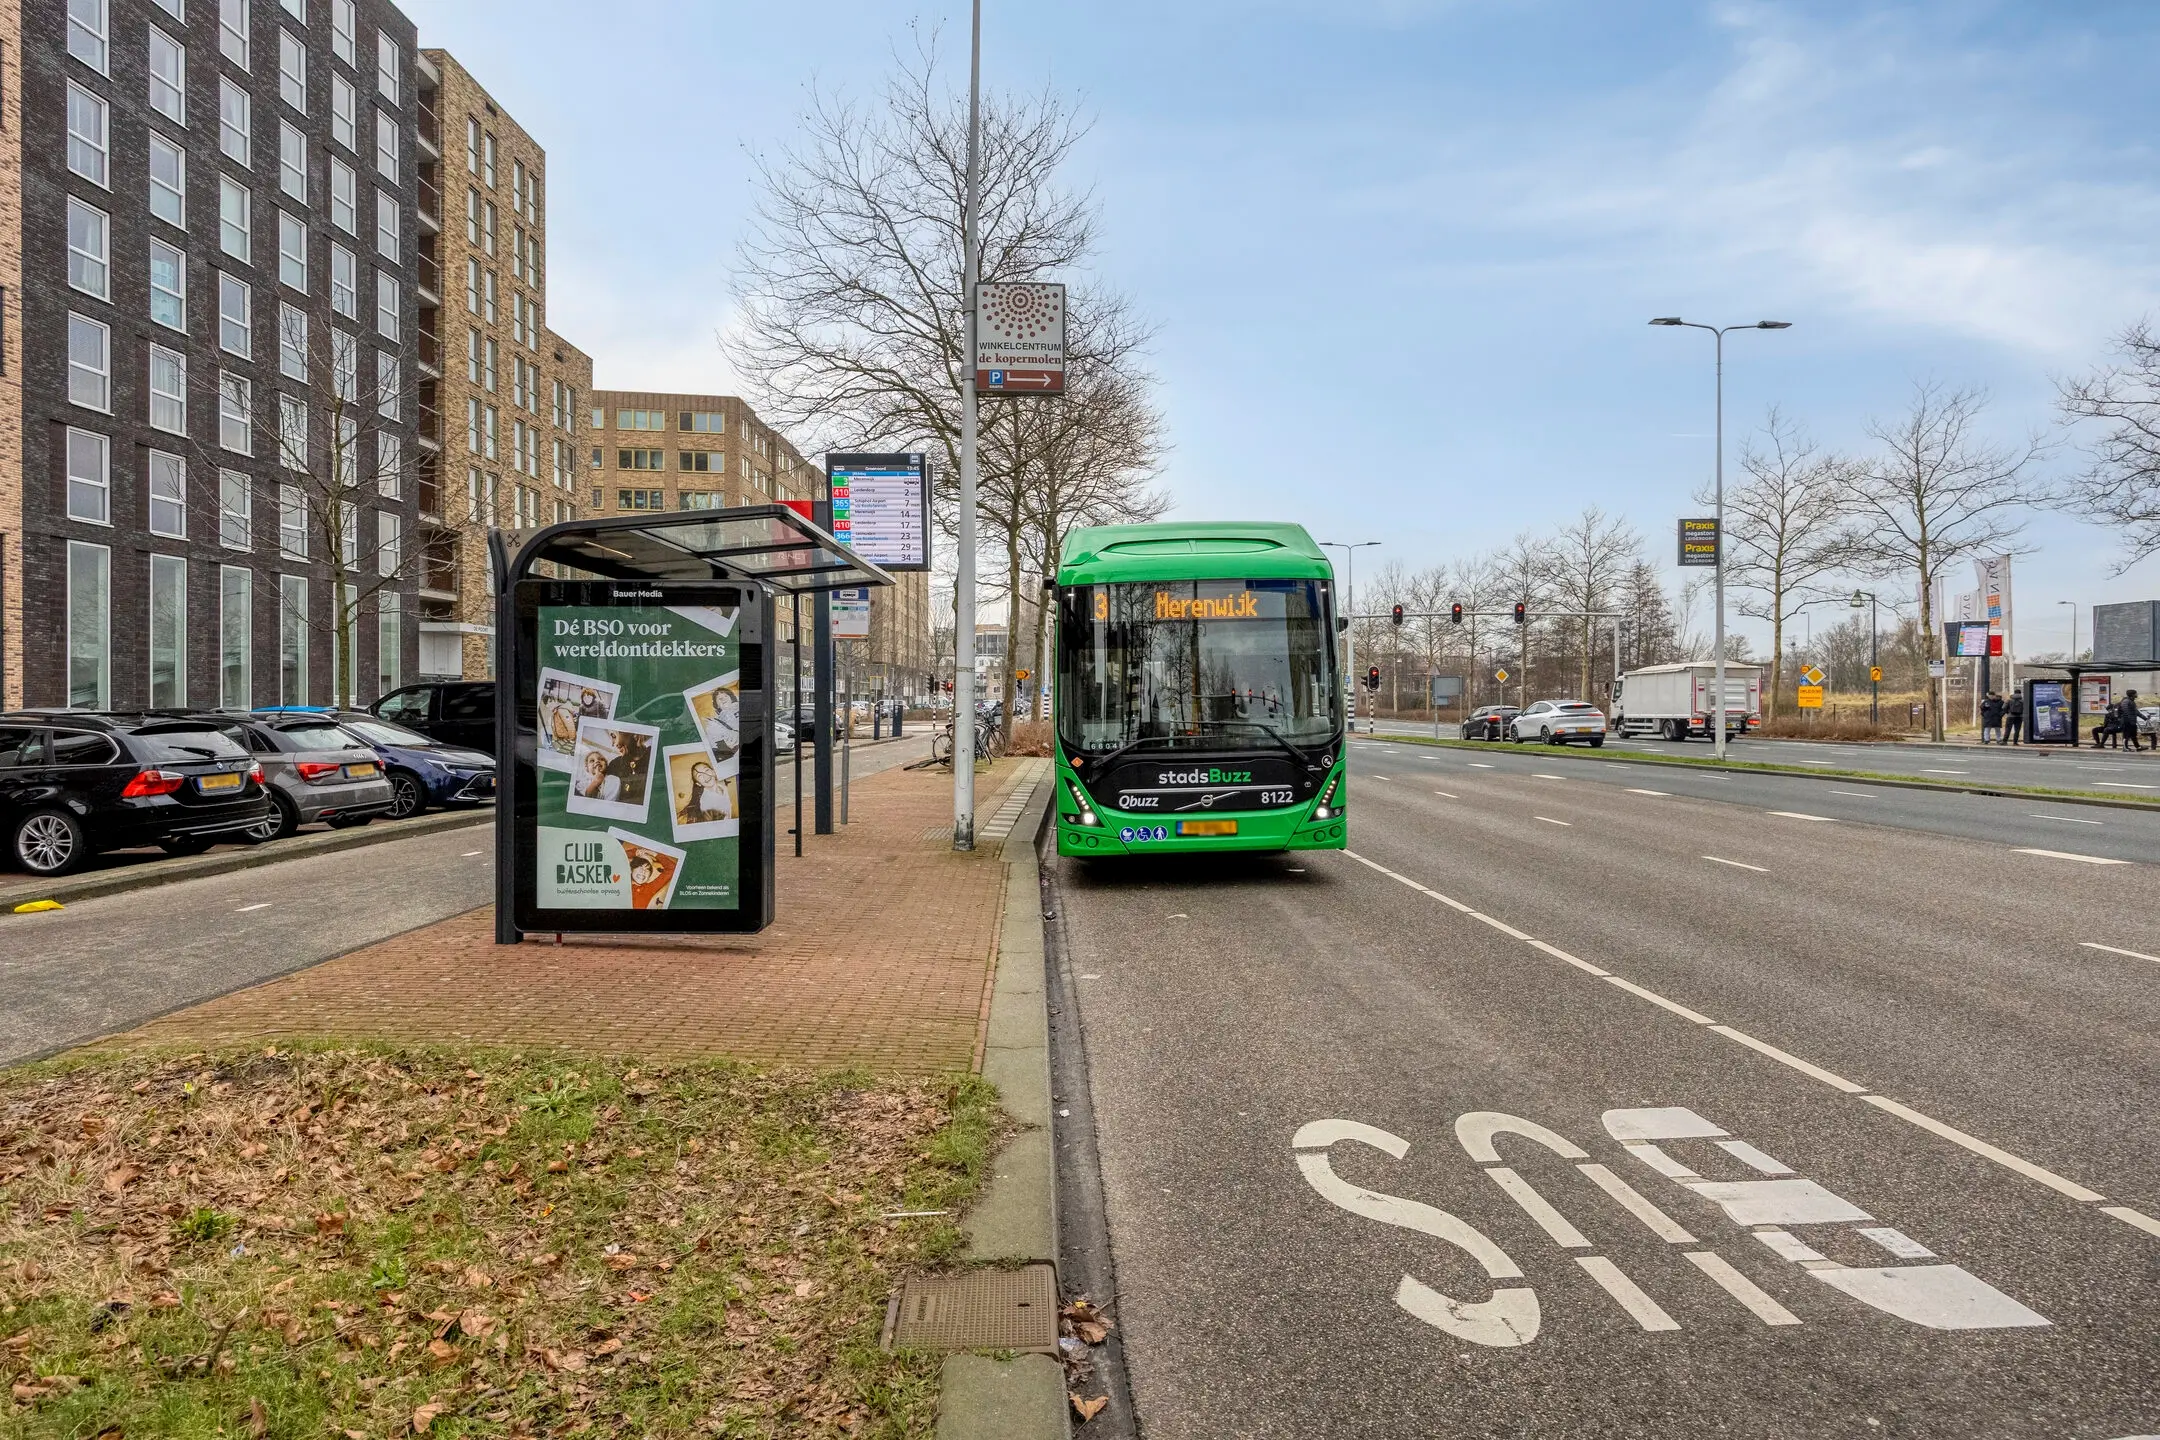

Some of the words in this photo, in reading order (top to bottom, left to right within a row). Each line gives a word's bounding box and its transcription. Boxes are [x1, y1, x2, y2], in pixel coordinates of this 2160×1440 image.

[979, 342, 1062, 351] WINKELCENTRUM
[978, 353, 992, 363] de
[995, 353, 1062, 365] kopermolen
[834, 488, 849, 497] 410
[835, 499, 849, 508] 365
[904, 500, 910, 508] 7
[900, 510, 910, 518] 14
[835, 521, 850, 529] 410
[900, 521, 910, 529] 17
[1685, 521, 1715, 530] Praxis
[836, 532, 850, 540] 366
[900, 532, 911, 540] 23
[900, 543, 911, 551] 29
[1685, 543, 1715, 552] Praxis
[613, 590, 637, 598] Bauer
[638, 590, 663, 598] Media
[1095, 592, 1107, 620] 3
[1156, 590, 1258, 618] Merenwijk
[554, 618, 579, 636] Dé
[583, 619, 624, 636] BSO
[628, 623, 672, 636] voor
[554, 640, 726, 657] wereldontdekkers
[1158, 768, 1252, 784] stadsBuzz
[1119, 795, 1159, 809] Qbuzz
[1261, 791, 1294, 804] 8122
[564, 842, 604, 862] CLUB
[556, 864, 612, 884] BASKER
[1292, 1106, 2054, 1347] BUS
